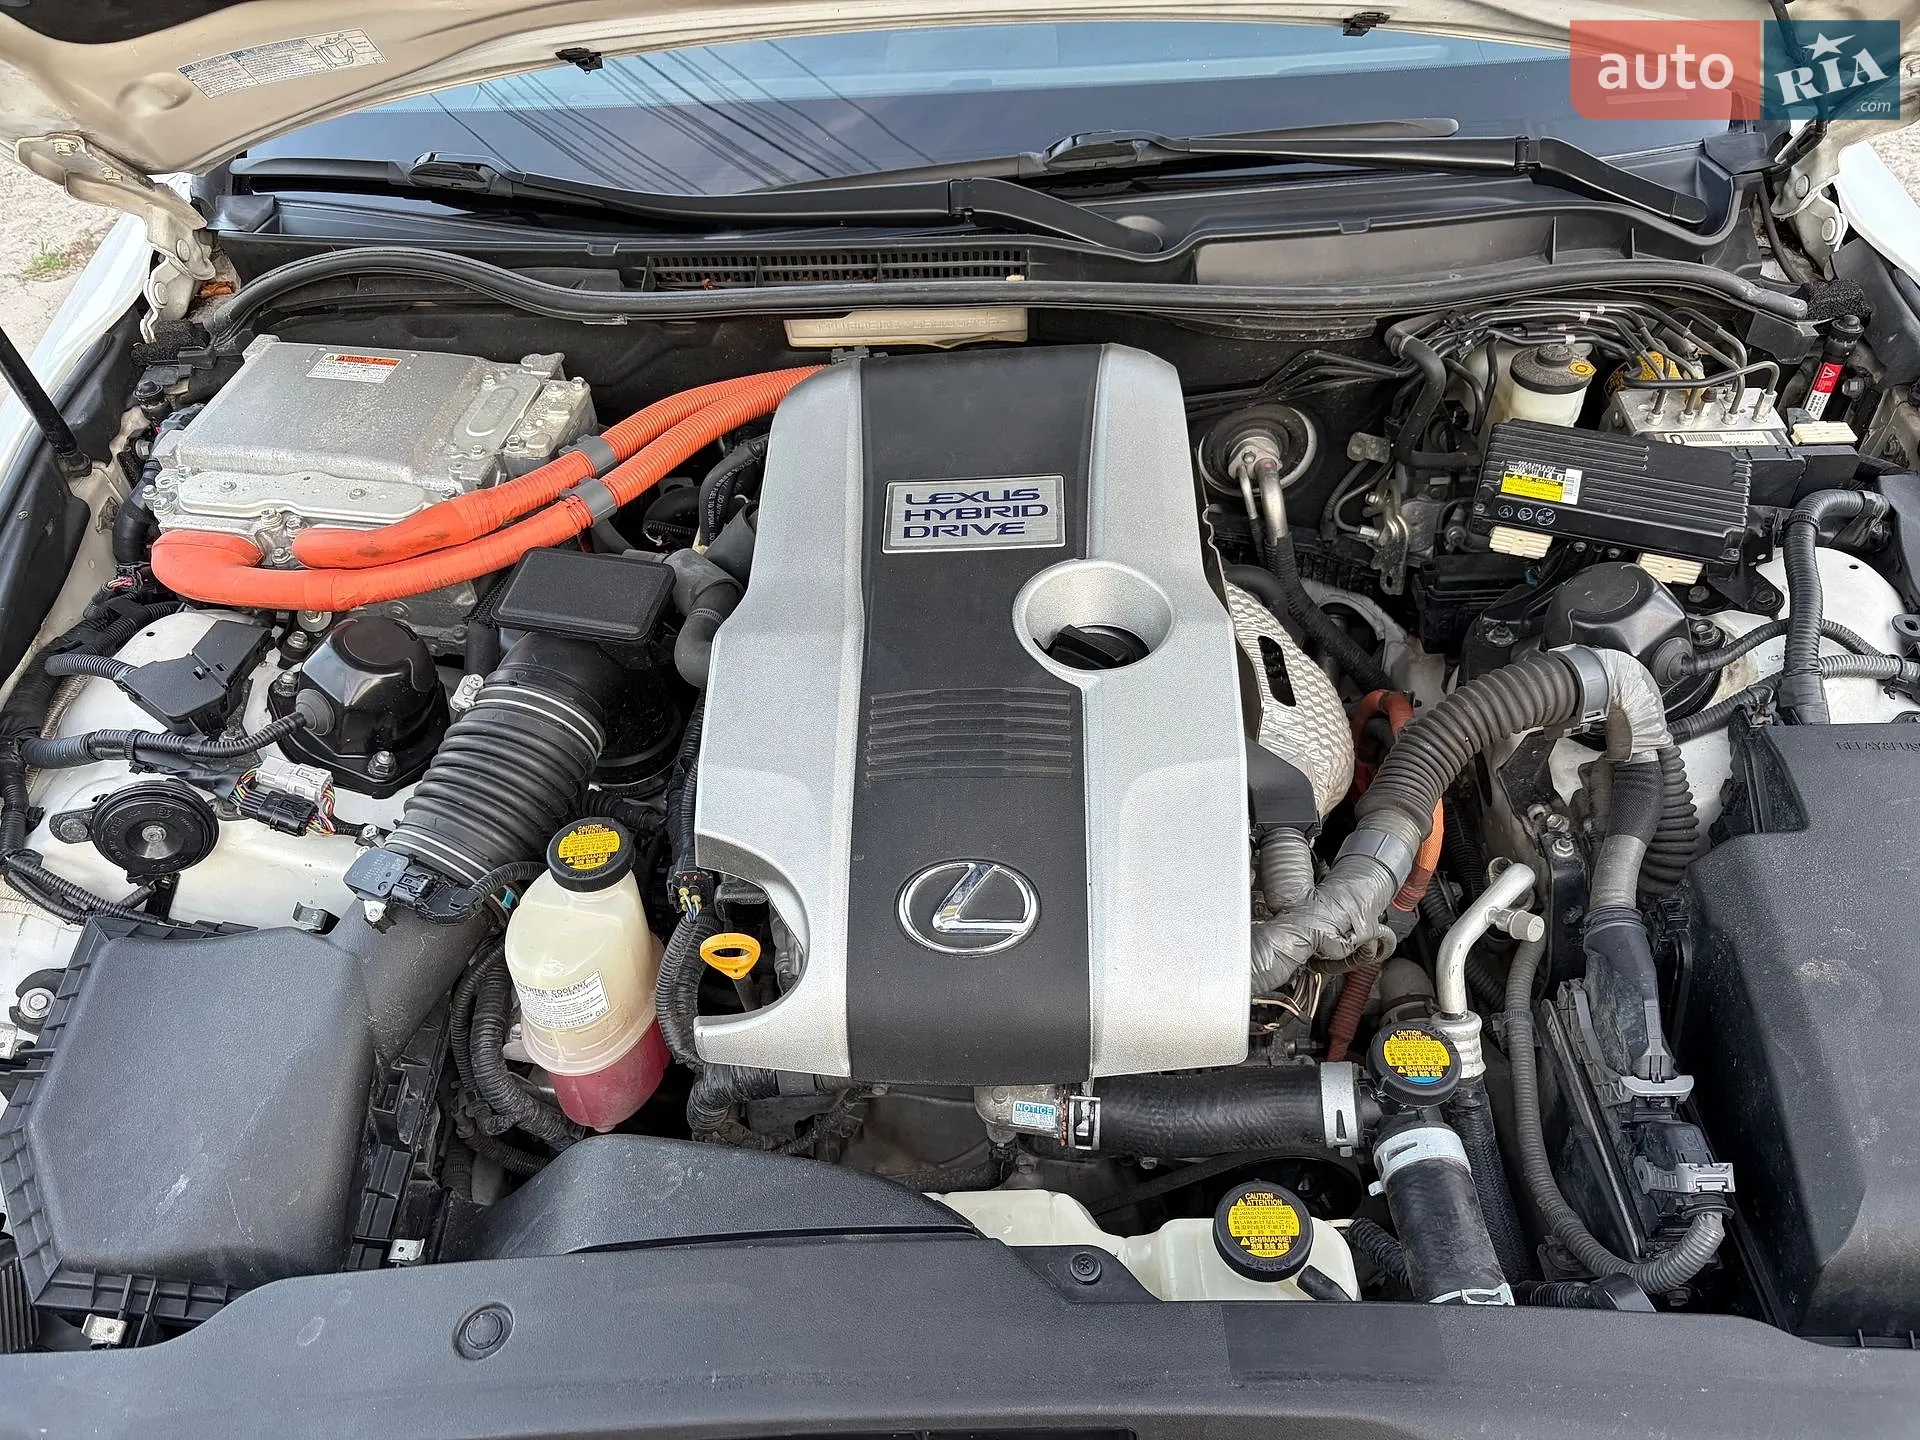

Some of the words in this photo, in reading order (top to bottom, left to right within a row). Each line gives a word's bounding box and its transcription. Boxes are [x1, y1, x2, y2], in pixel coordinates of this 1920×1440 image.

[905, 488, 1041, 505] LEXUS
[904, 504, 1049, 522] HYBRID
[903, 521, 1026, 539] DRIVE
[551, 980, 587, 996] COOLANT
[1016, 1103, 1053, 1115] NOTICE
